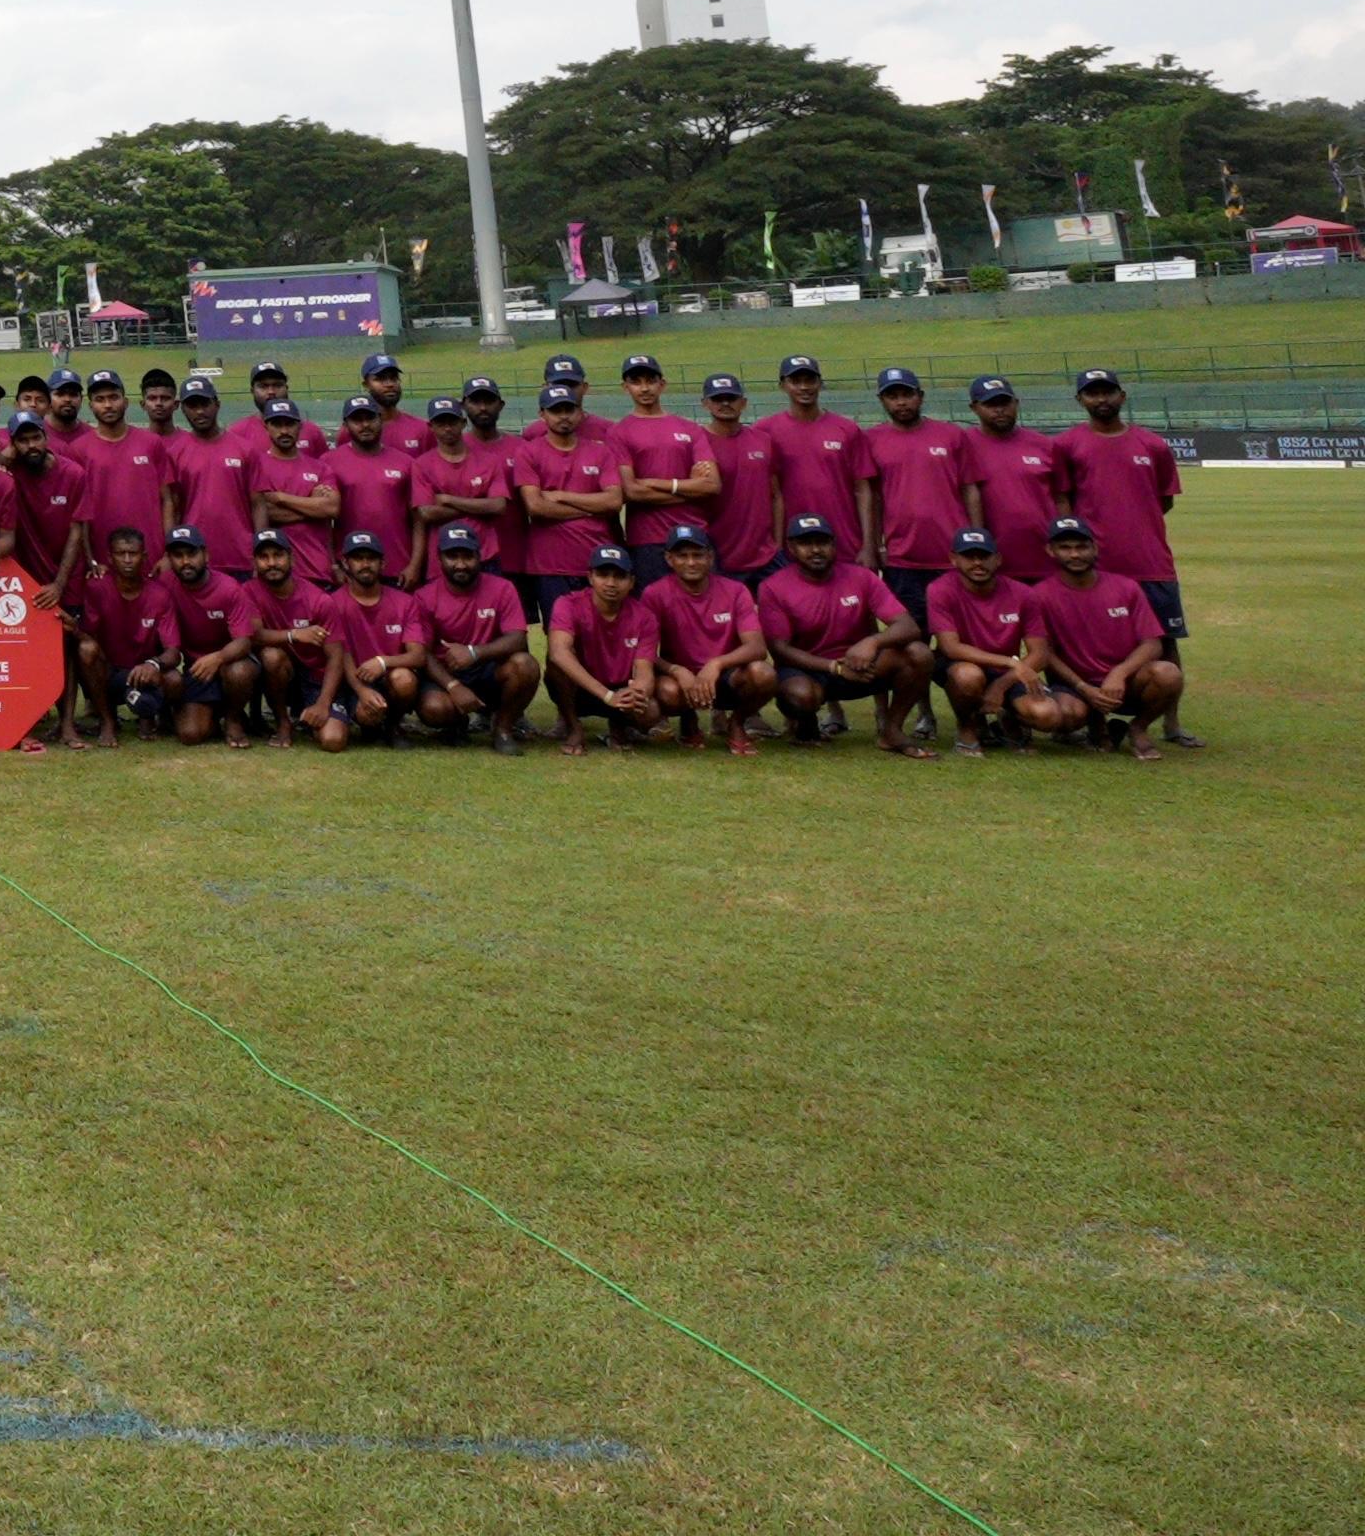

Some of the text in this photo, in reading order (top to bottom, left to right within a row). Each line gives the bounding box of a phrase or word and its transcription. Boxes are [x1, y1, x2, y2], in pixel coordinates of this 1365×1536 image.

[216, 293, 371, 309] BIGGER. FASTER. STRONGER
[1277, 437, 1359, 447] 1852 CEYLON
[1279, 447, 1332, 458] PREMIUM
